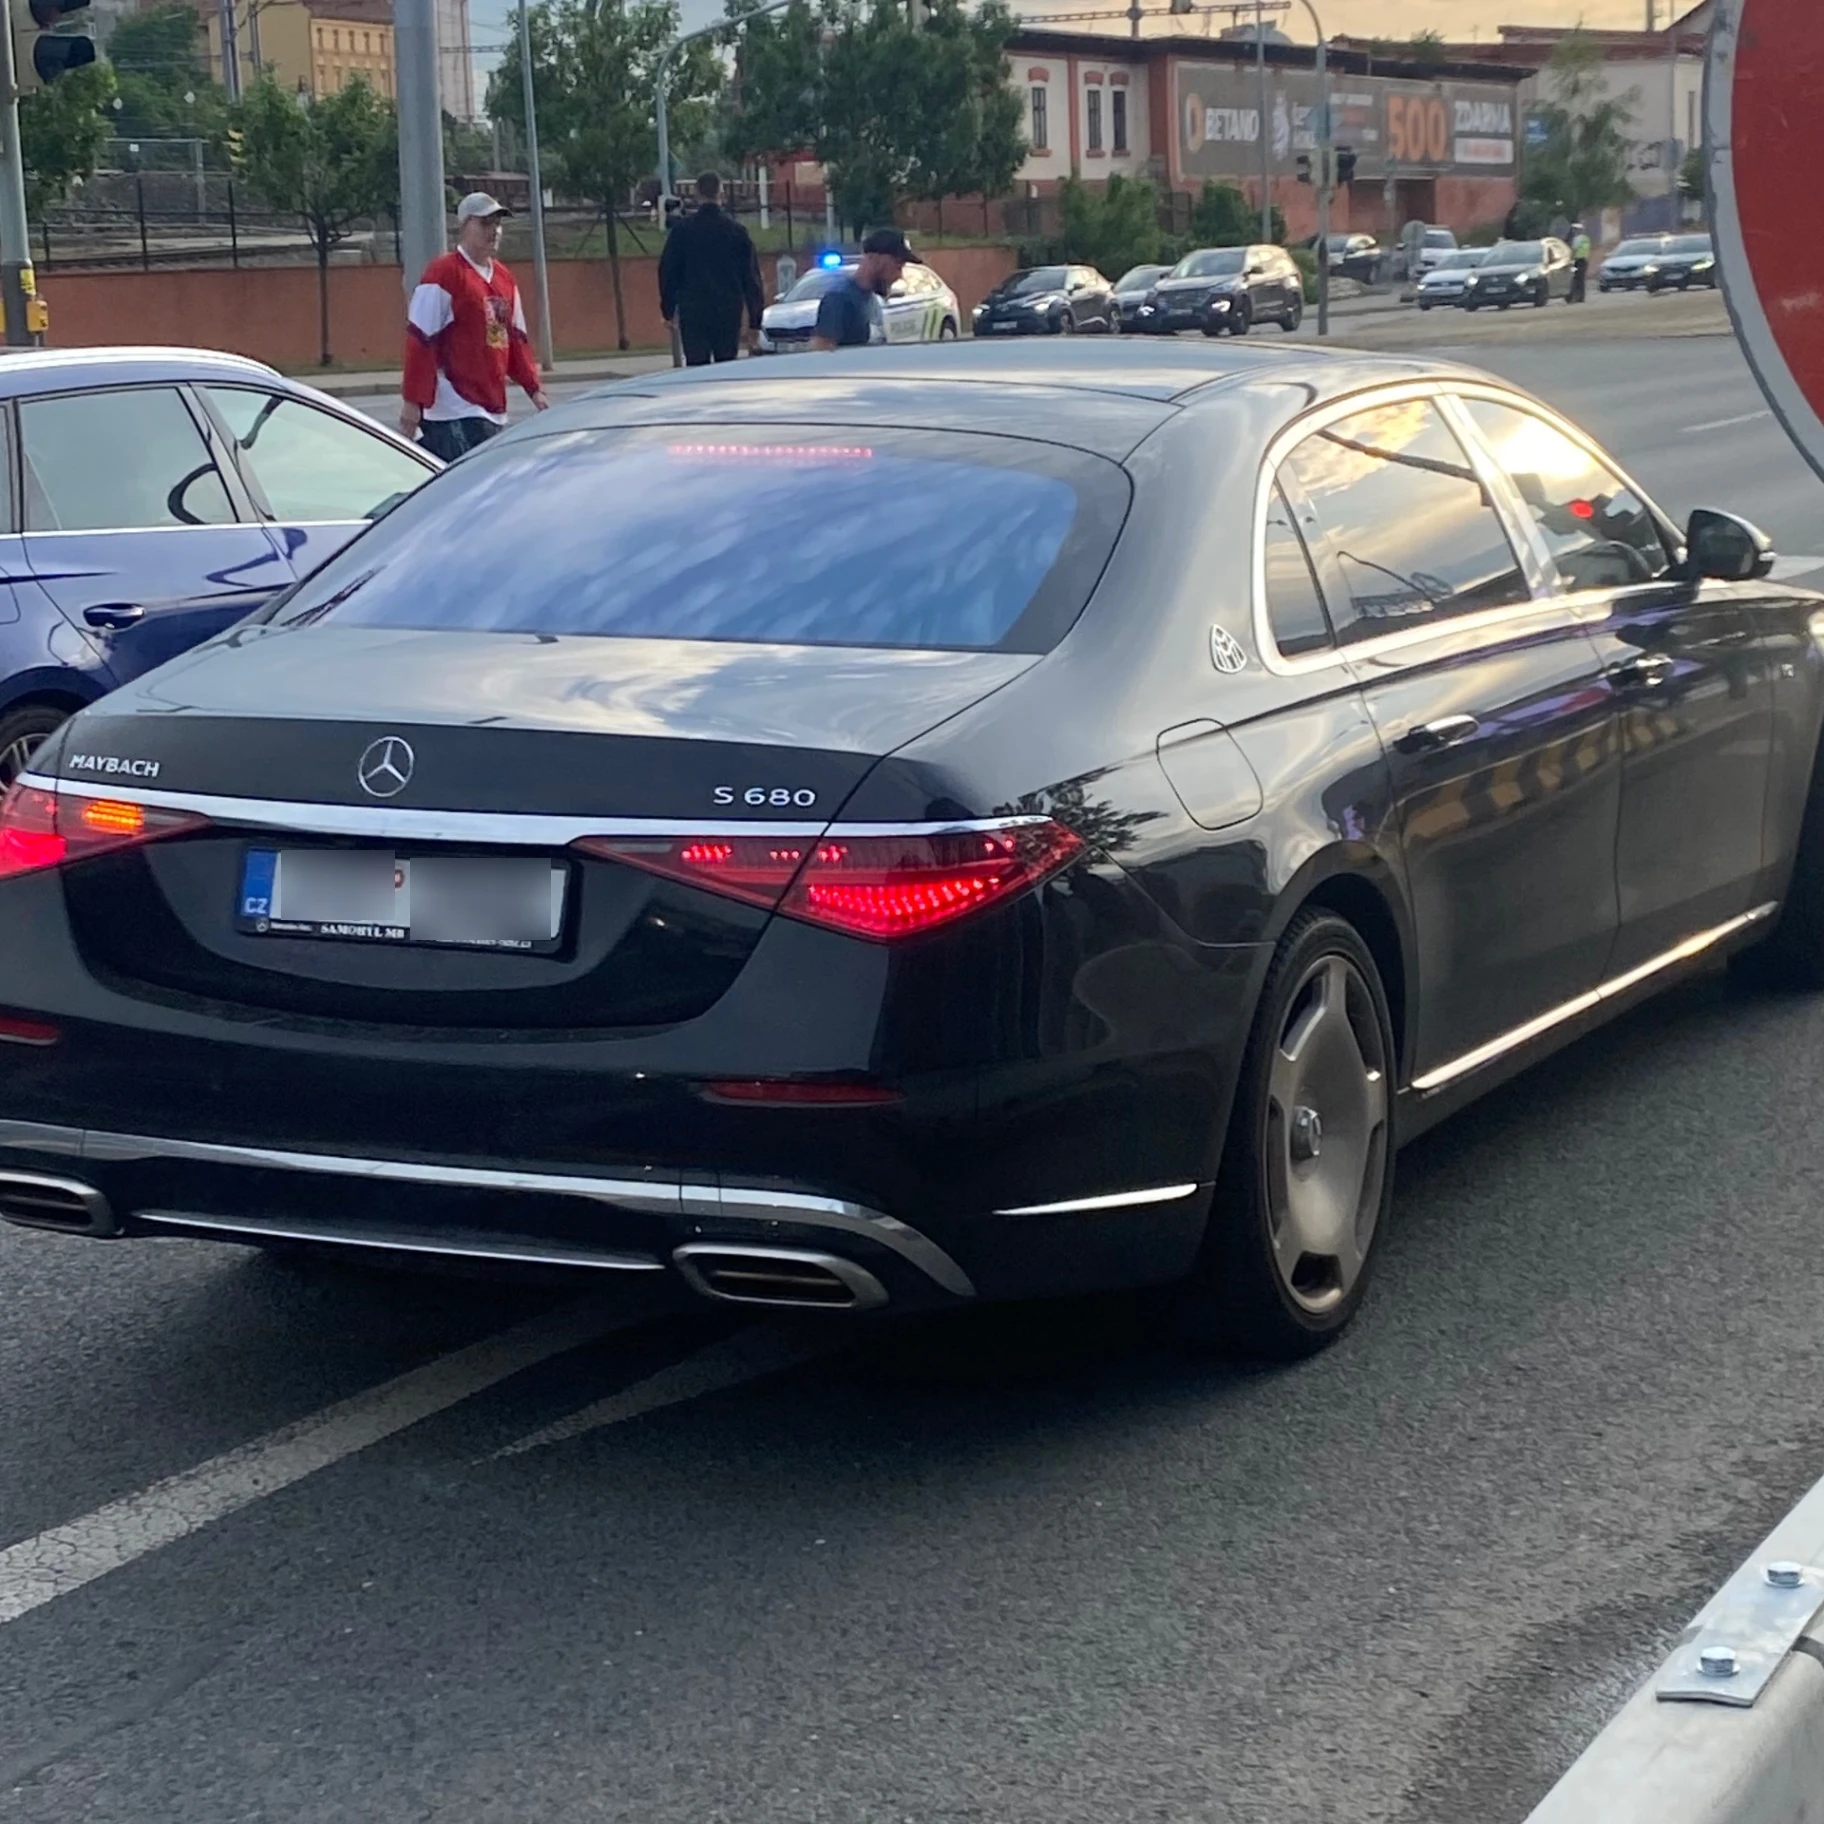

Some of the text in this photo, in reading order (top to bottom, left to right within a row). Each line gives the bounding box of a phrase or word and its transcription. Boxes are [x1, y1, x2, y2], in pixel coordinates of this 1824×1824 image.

[1205, 107, 1260, 141] BETANO
[1388, 96, 1446, 162] 500
[1454, 101, 1512, 133] ZDARMA
[69, 754, 160, 777] MAYBACH
[713, 786, 816, 806] S 680
[244, 897, 268, 914] CZ
